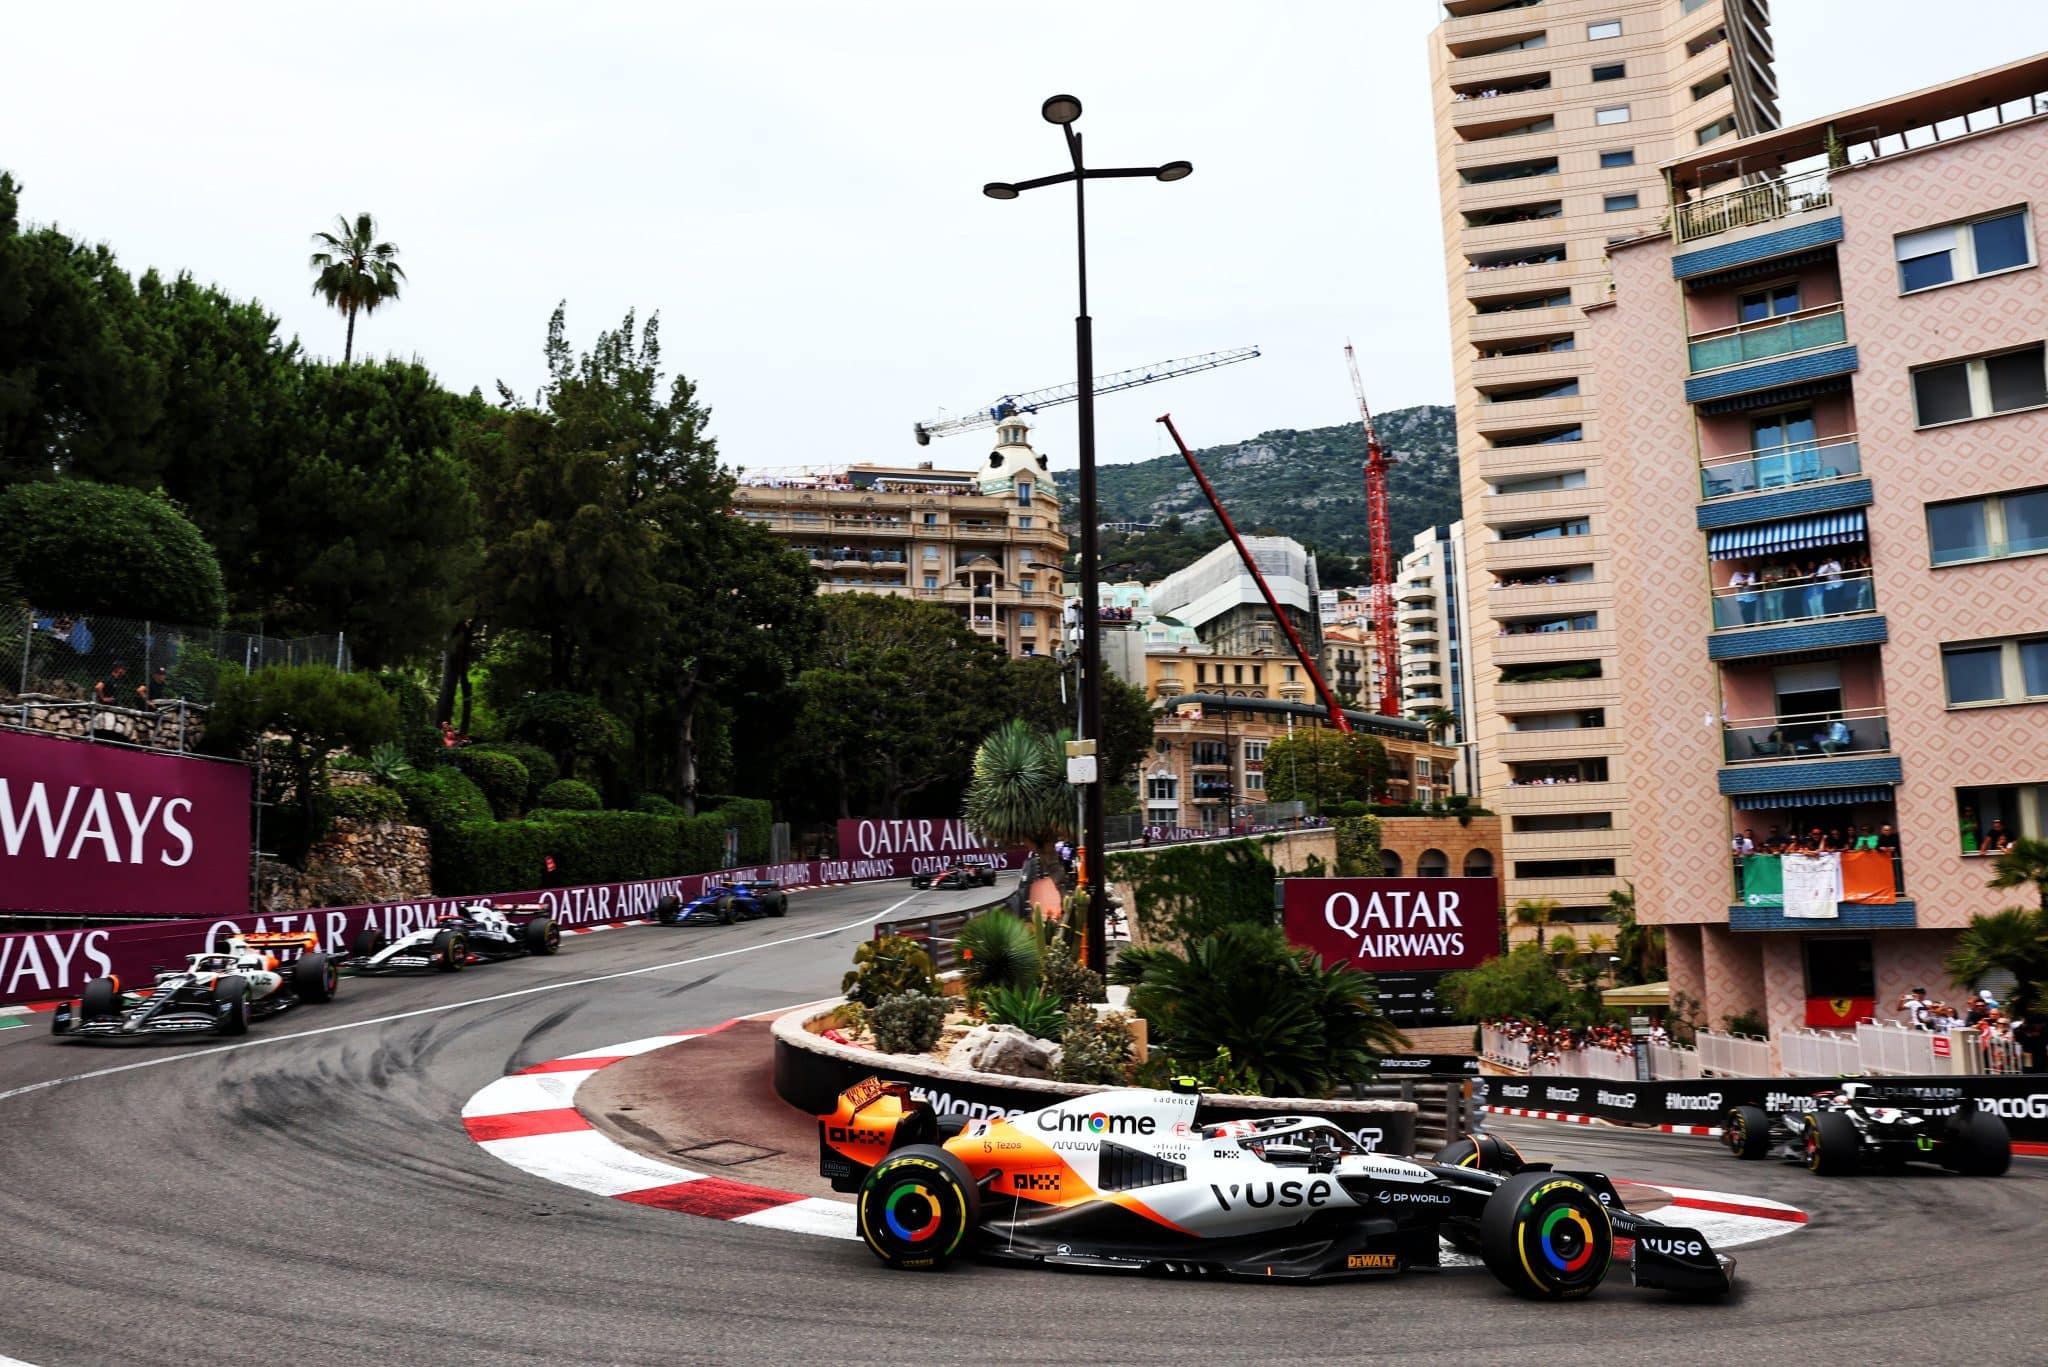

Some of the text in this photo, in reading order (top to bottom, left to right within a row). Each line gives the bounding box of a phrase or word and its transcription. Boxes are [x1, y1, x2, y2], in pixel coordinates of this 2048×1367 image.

[0, 777, 193, 866] WAYS
[858, 819, 934, 858] QATAR
[820, 858, 894, 882] QATAR AIRWAYS
[912, 855, 951, 875] QATAR
[539, 887, 612, 926] QATAR
[1324, 890, 1464, 939] QATAR
[363, 898, 492, 945] AIRW
[1358, 932, 1465, 959] AIRWAYS
[1153, 1096, 1196, 1106] cadence
[1665, 1092, 1722, 1111] #MonacoGP
[1037, 1109, 1156, 1136] Chrome
[829, 1127, 887, 1145] OKX
[996, 1141, 1022, 1151] Tezos
[1214, 1150, 1239, 1159] OKX
[889, 1158, 939, 1170] ZERO
[1363, 1165, 1429, 1178] RICHARD MILLE
[1013, 1174, 1060, 1190] OKX
[1540, 1180, 1585, 1194] ZERO
[1393, 1193, 1451, 1204] DP WORLD
